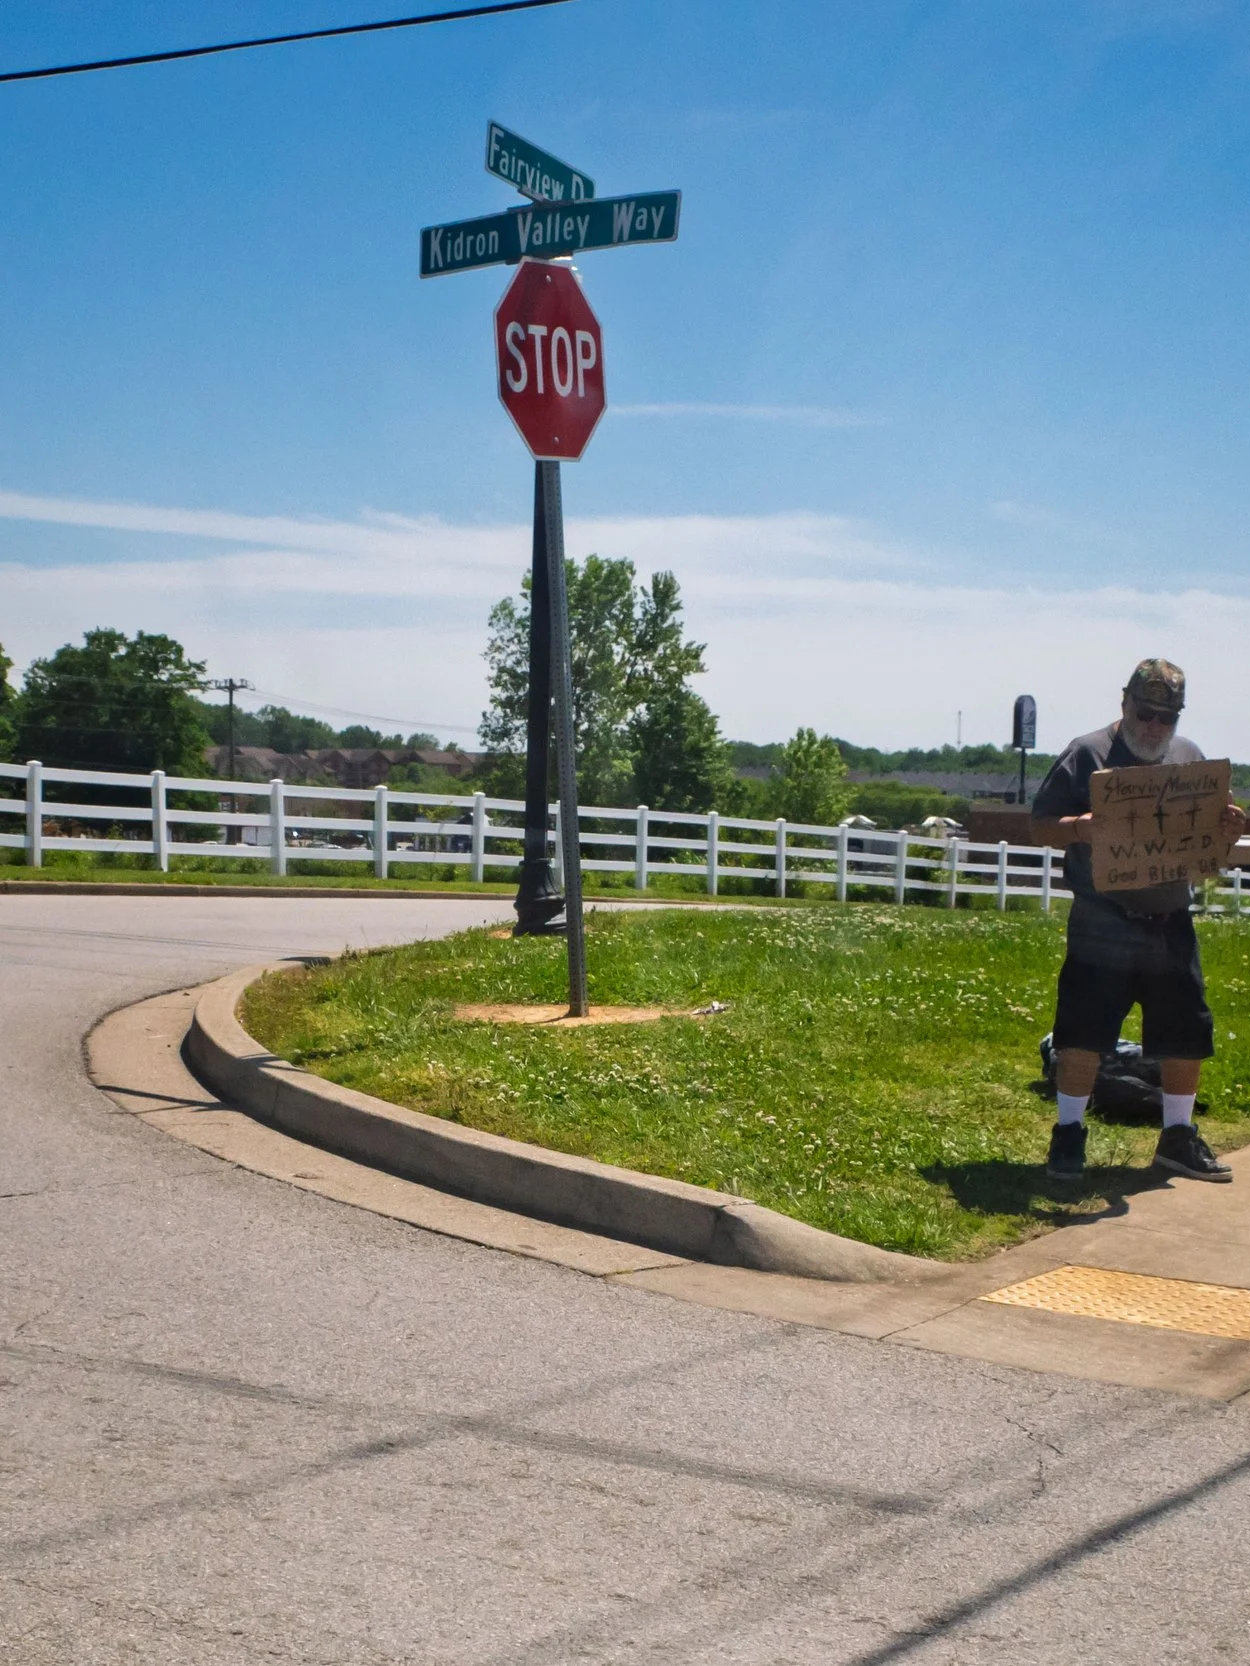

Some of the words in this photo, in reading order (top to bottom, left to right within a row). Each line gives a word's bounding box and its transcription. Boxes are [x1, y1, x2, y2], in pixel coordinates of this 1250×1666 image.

[489, 126, 564, 201] Fairview
[430, 228, 499, 269] Kidron
[517, 211, 590, 252] Valley
[613, 201, 665, 243] Way
[506, 321, 597, 398] STOP
